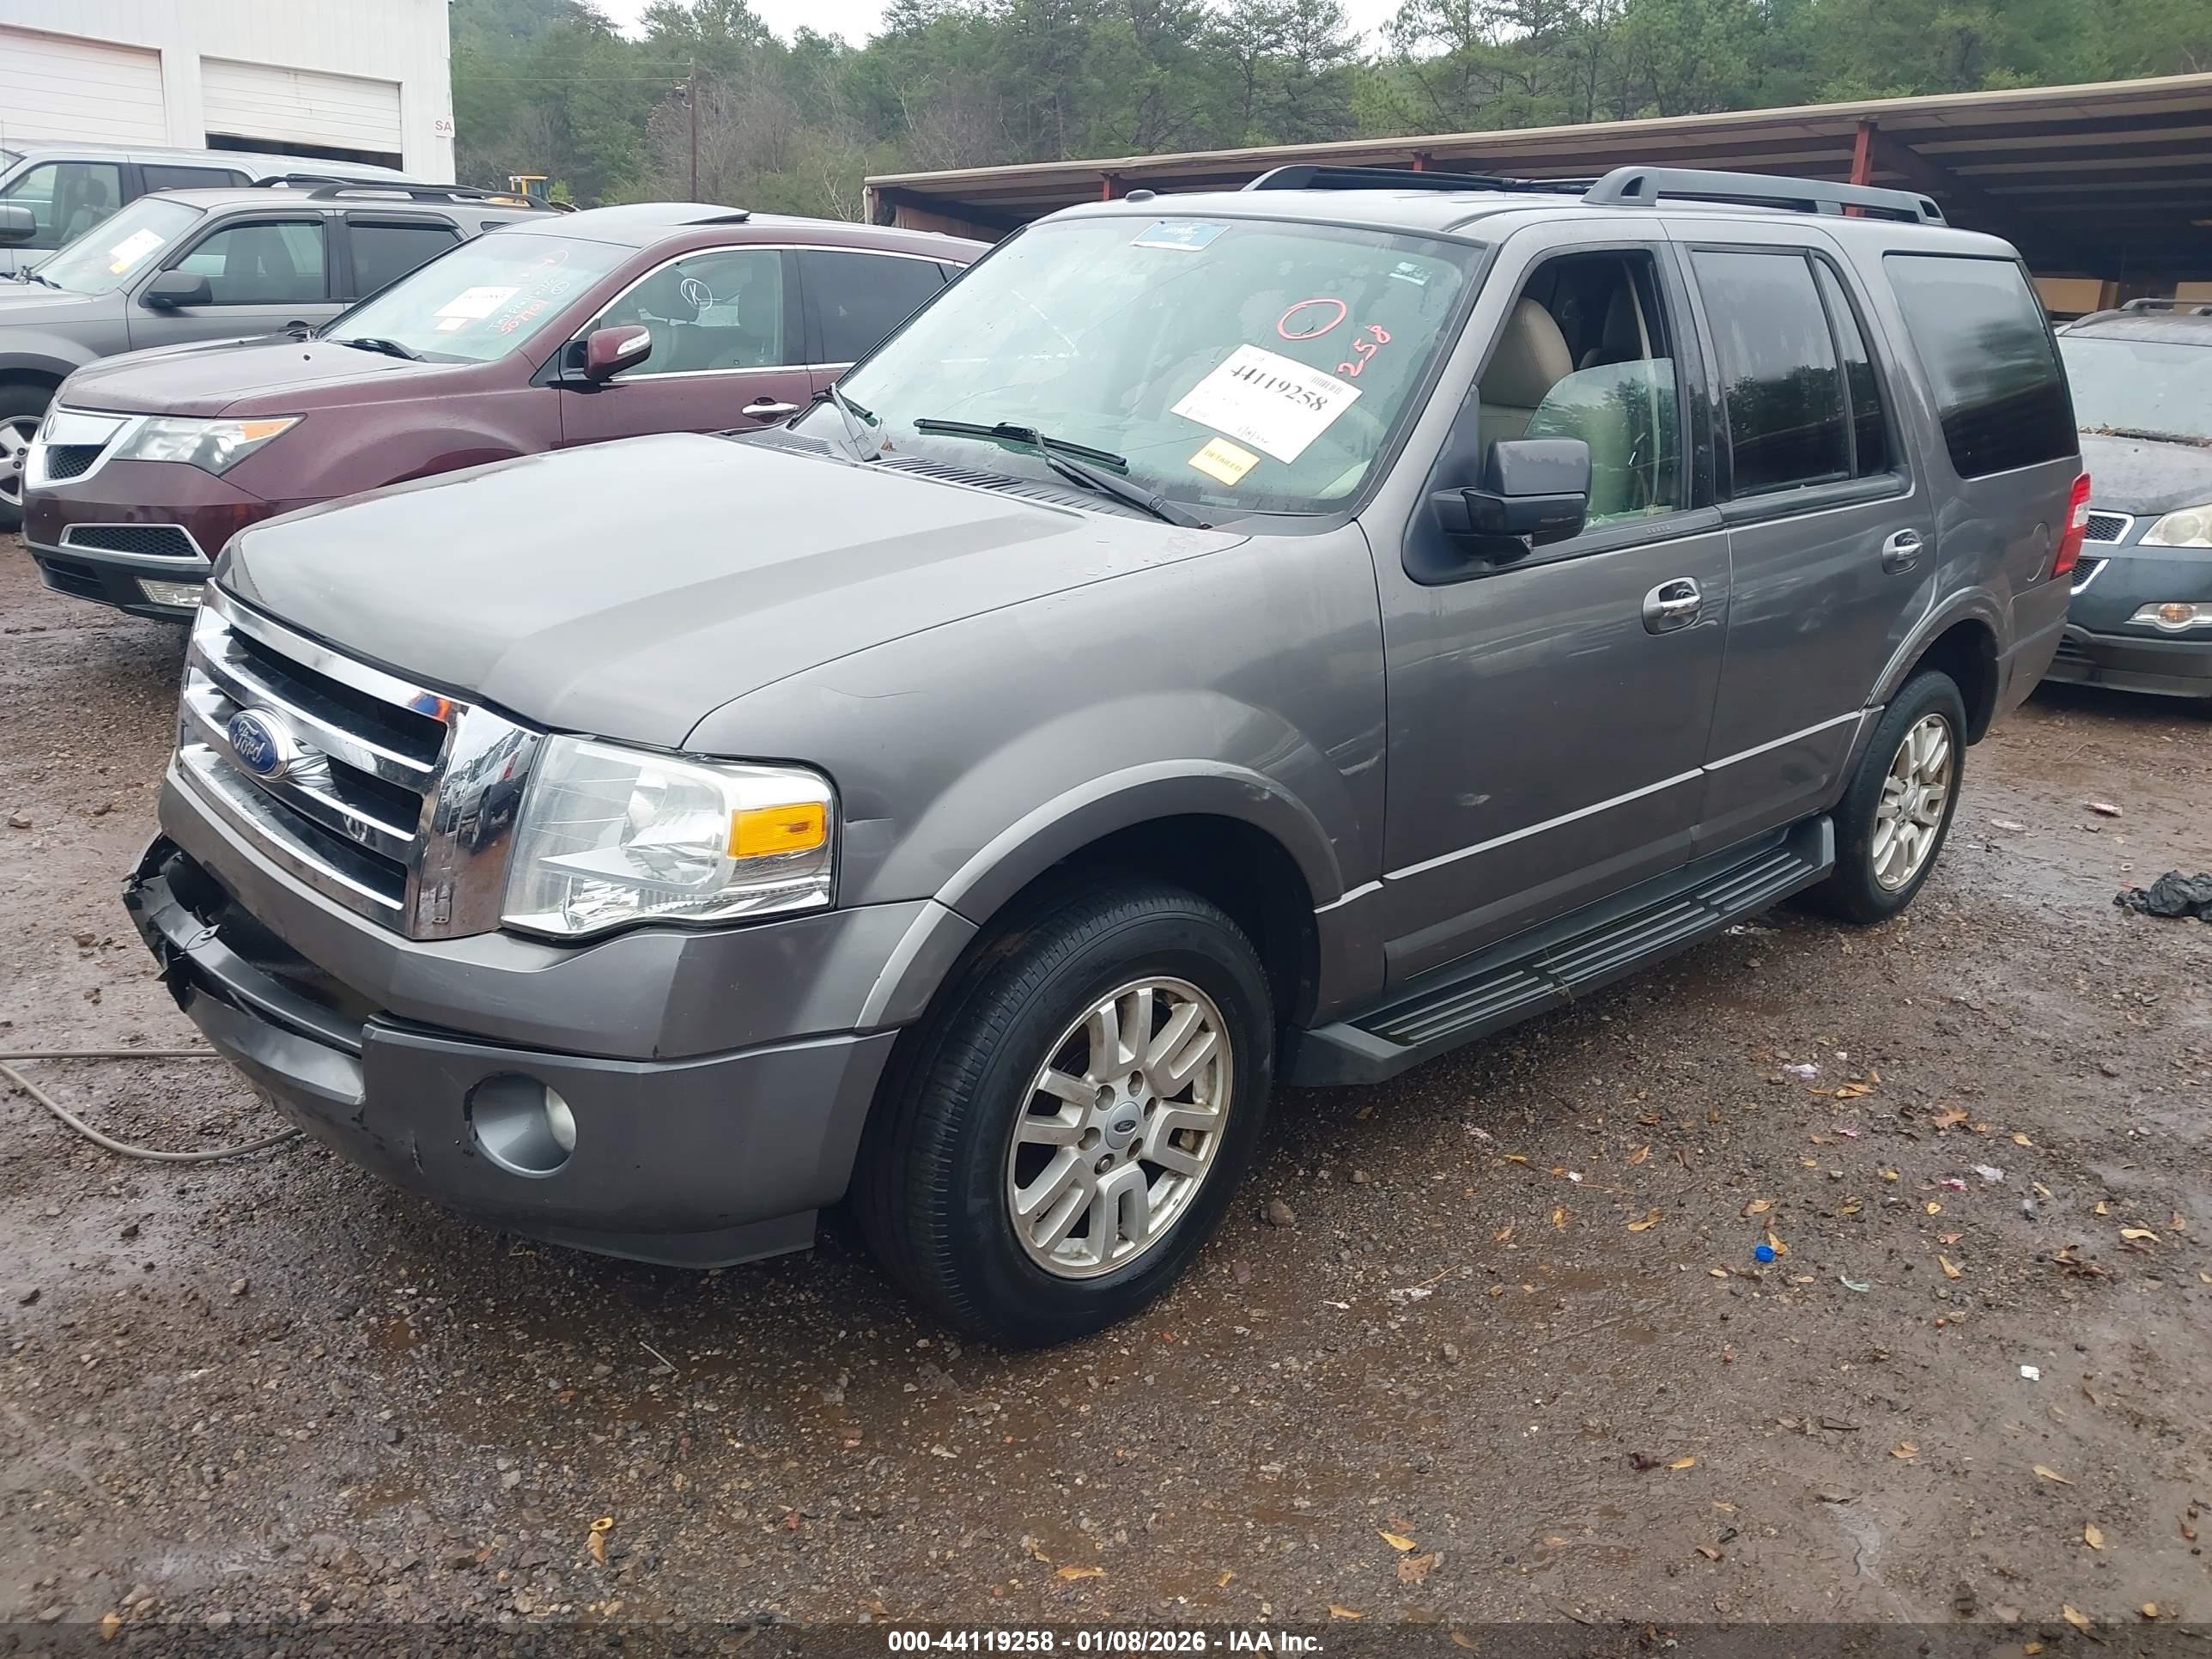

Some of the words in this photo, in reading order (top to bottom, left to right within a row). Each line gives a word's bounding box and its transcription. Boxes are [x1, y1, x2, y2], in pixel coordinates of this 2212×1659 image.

[435, 120, 453, 131] SA
[1338, 325, 1391, 377] 258
[1231, 365, 1328, 410] 44119258
[1204, 449, 1243, 472] DETAILED
[234, 720, 266, 763] Ford
